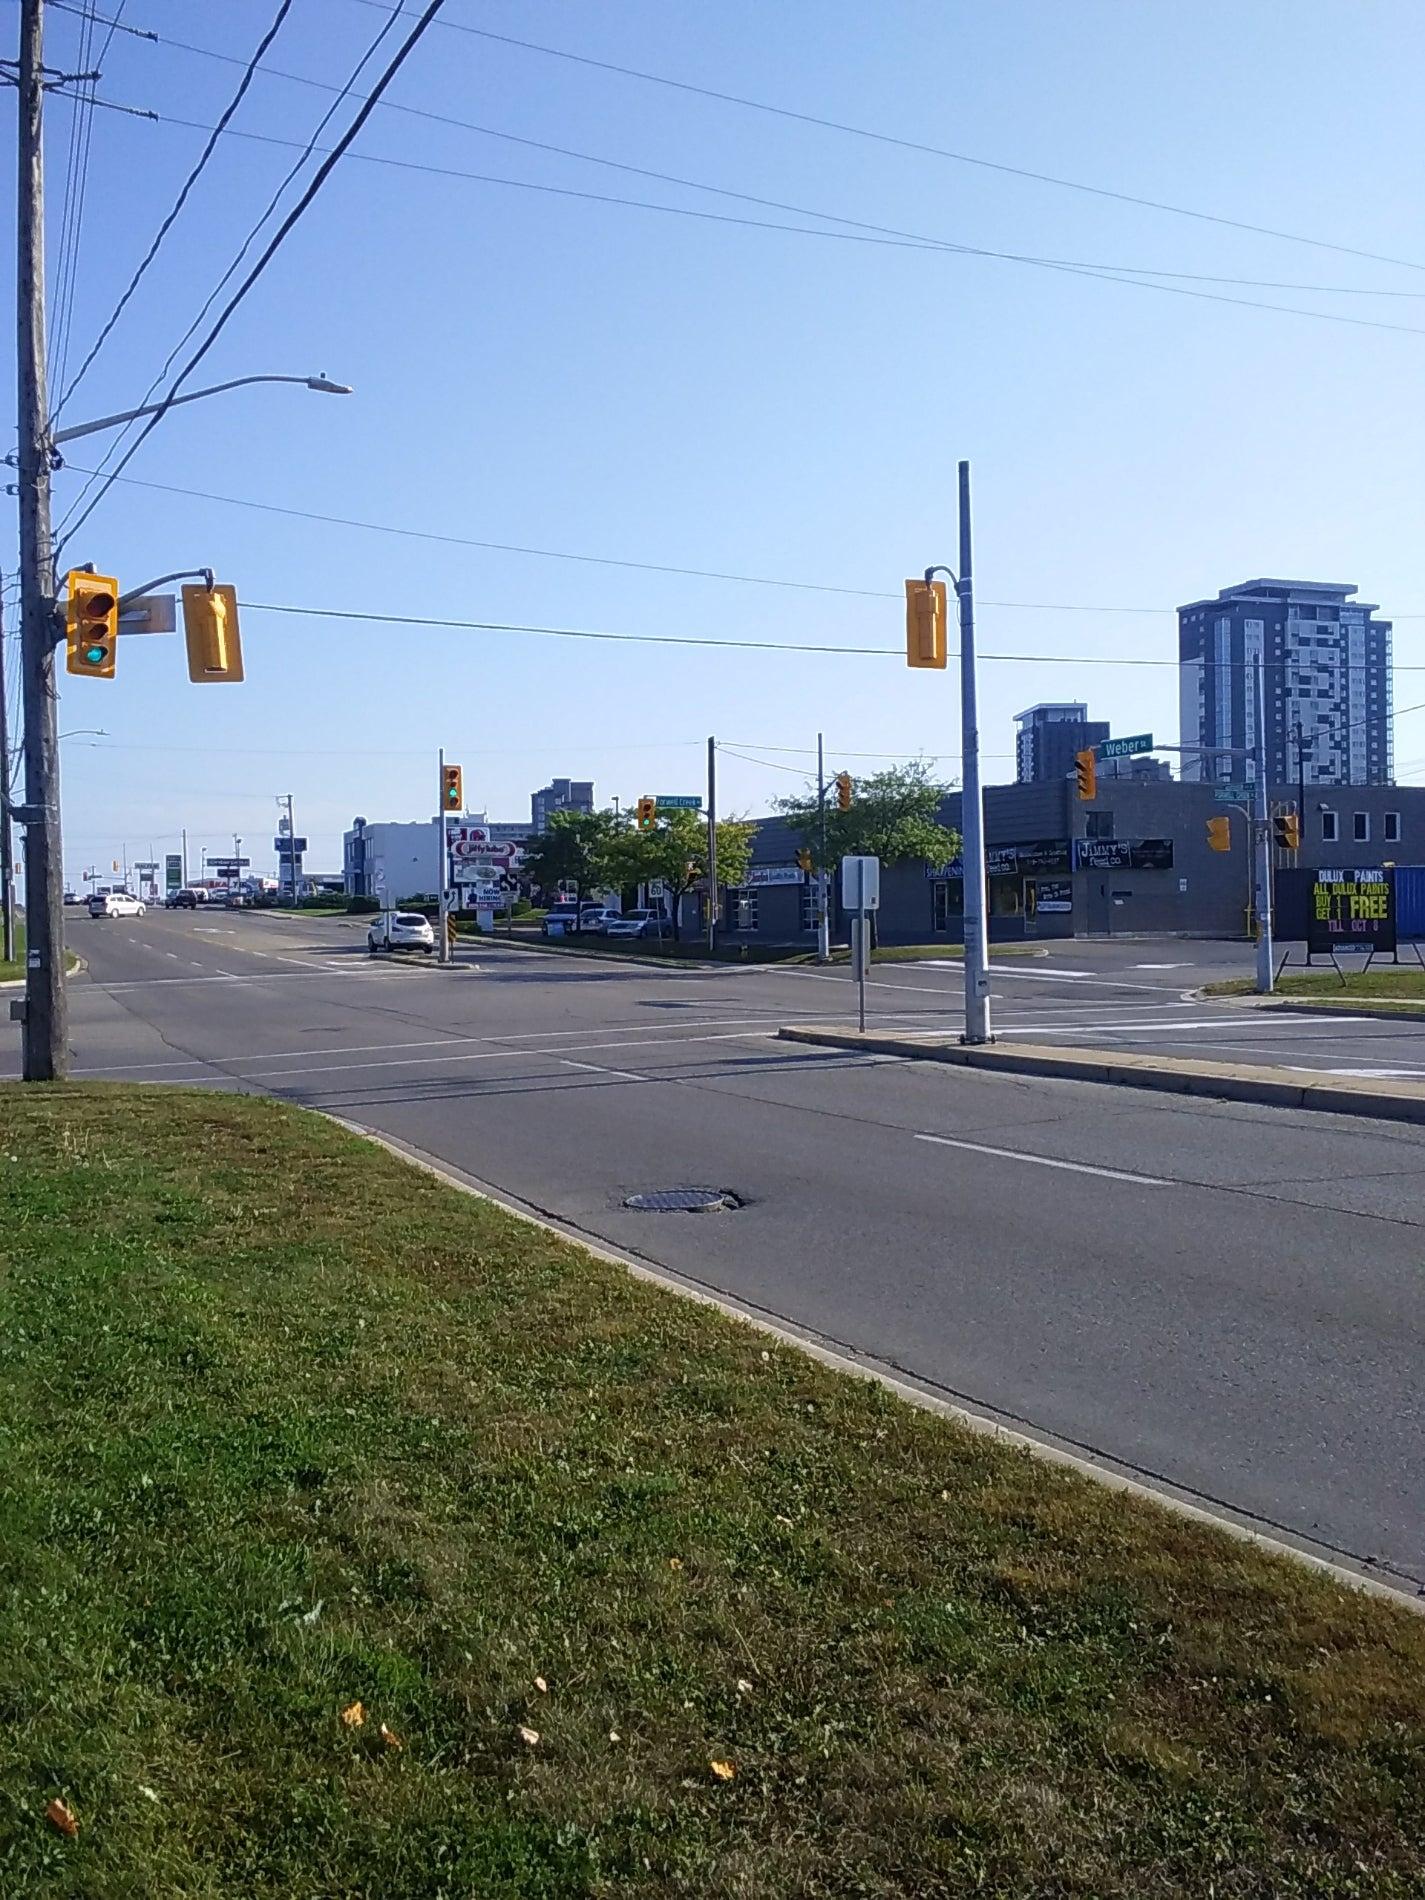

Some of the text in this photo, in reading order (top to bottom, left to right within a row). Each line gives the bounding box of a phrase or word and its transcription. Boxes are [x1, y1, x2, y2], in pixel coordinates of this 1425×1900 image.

[1106, 741, 1139, 756] Weber
[1318, 870, 1385, 883] DULUX PAINTS
[1313, 882, 1391, 895] ALL DULUX PAINTS
[1315, 895, 1342, 908] BUY 1
[1350, 895, 1389, 919] FREE
[1316, 908, 1342, 920] GET 1
[1328, 919, 1344, 932] TILL
[1351, 919, 1367, 932] OCT
